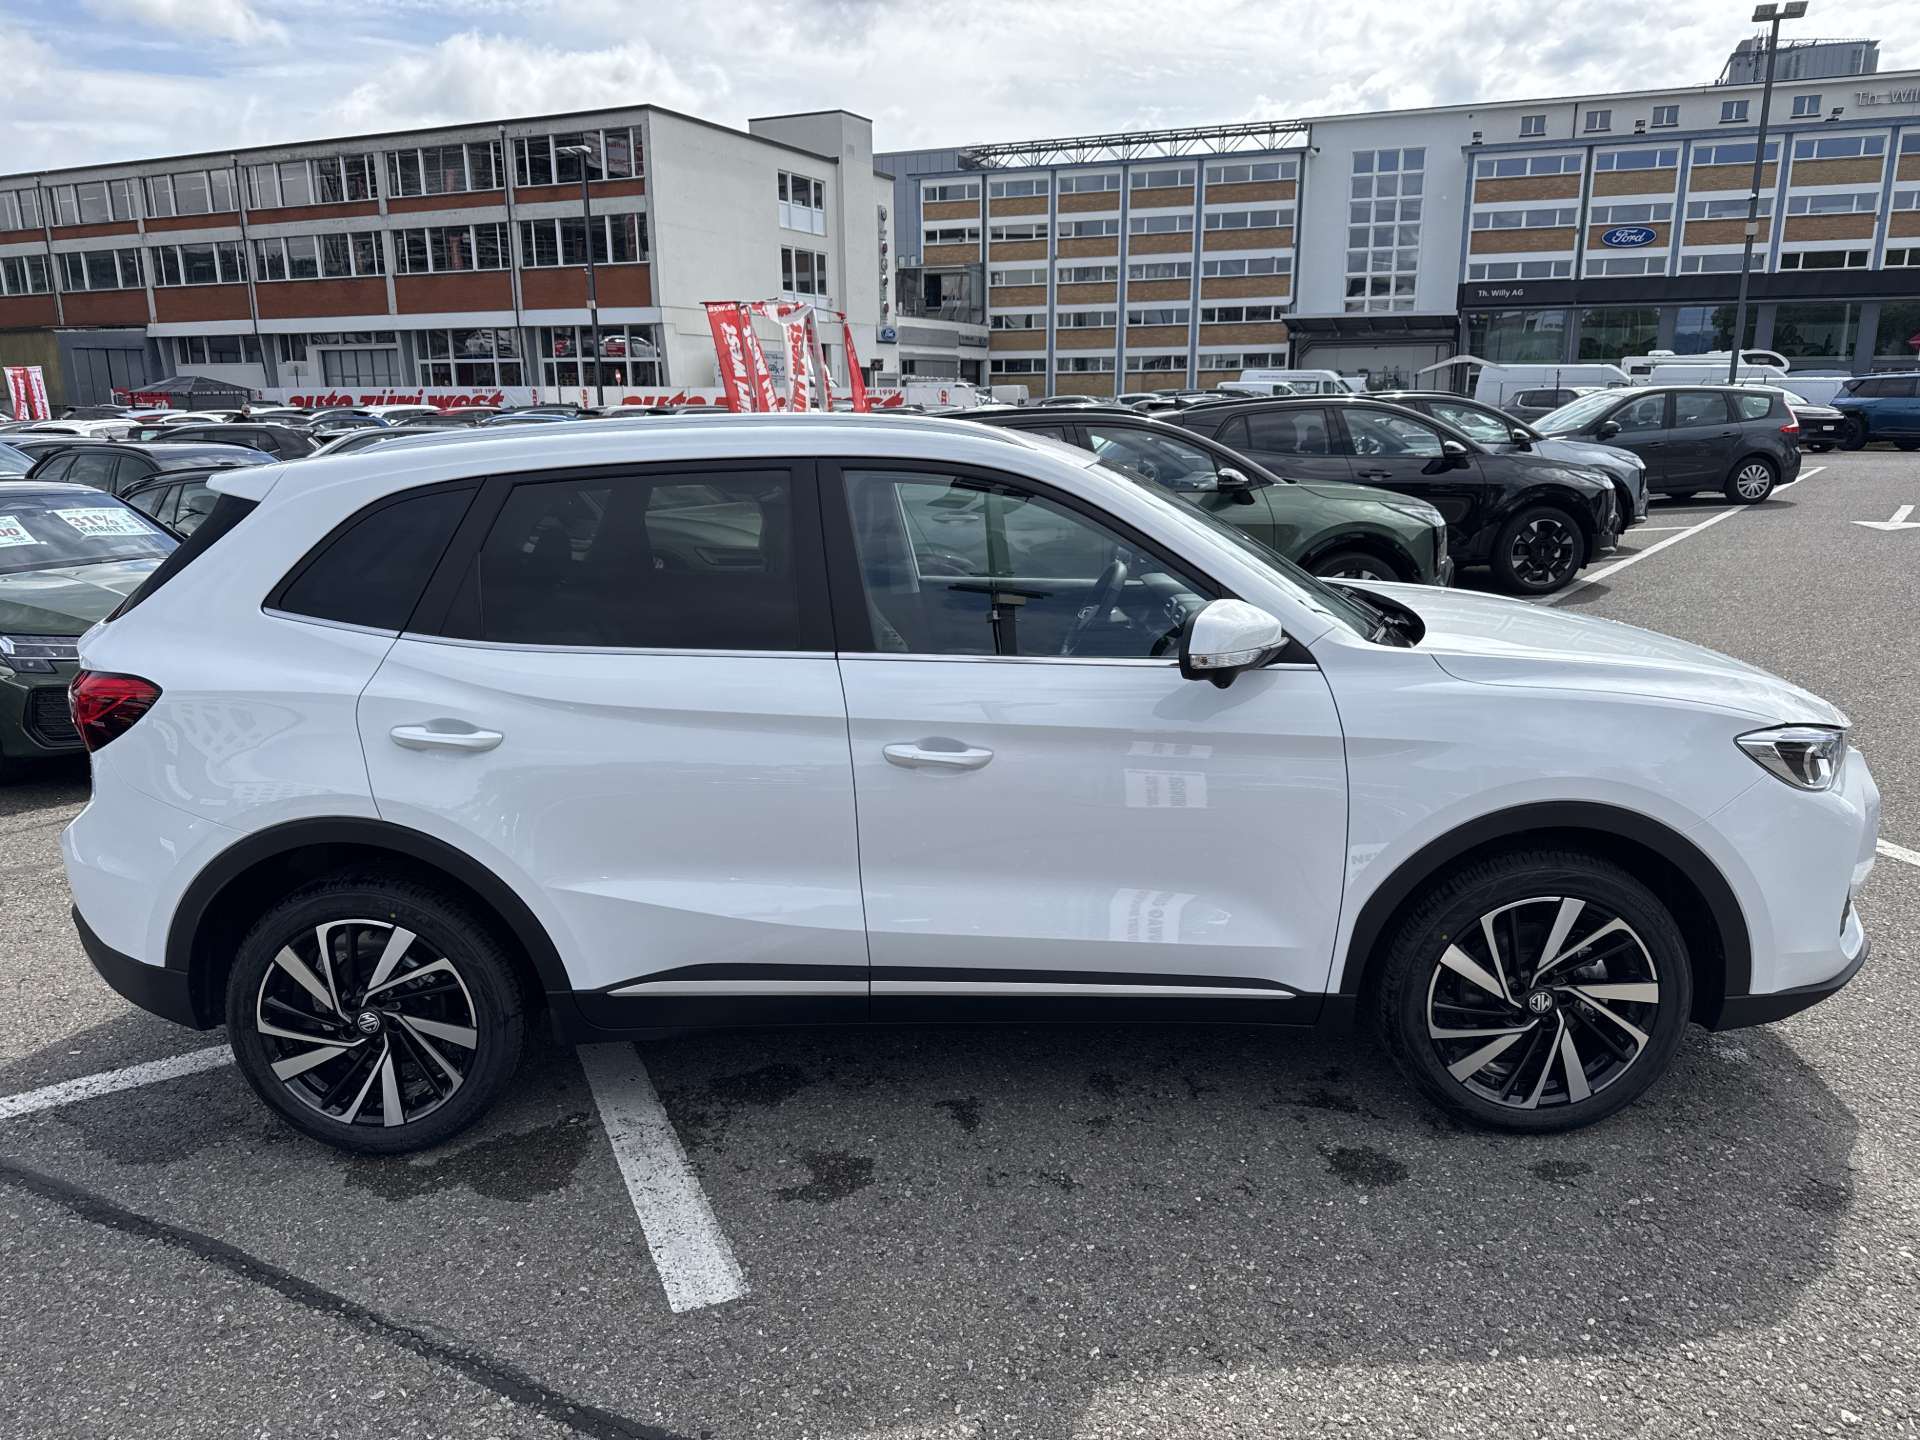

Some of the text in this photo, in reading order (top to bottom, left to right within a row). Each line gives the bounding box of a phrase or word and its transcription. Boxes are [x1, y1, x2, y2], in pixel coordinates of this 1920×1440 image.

[1612, 229, 1646, 243] Ford
[1491, 289, 1511, 298] Willy
[1512, 288, 1524, 296] AG
[66, 514, 120, 527] 31%
[359, 1013, 378, 1032] MG
